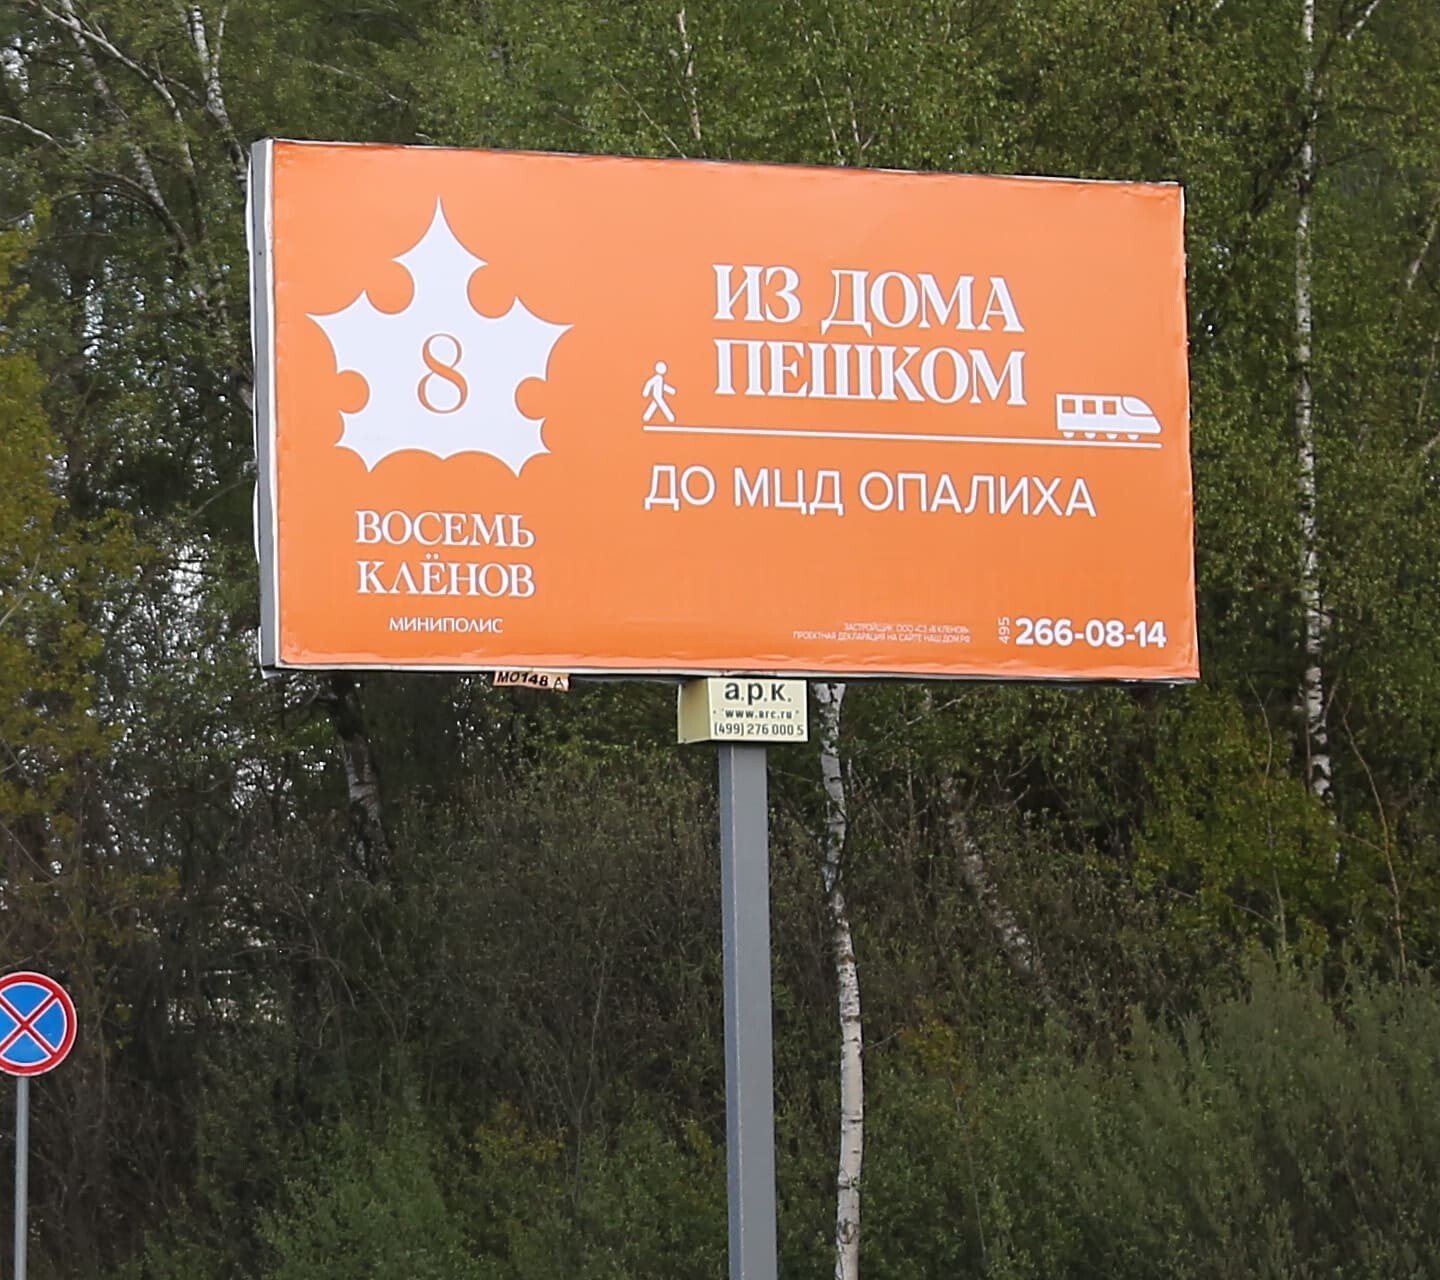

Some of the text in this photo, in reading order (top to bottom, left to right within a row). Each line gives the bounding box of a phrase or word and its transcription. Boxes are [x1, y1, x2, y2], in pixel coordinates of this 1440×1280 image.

[712, 264, 1025, 338] ИЗ ДОМА
[417, 332, 469, 415] 8
[713, 338, 1028, 406] ПЕШКОМ
[643, 464, 1097, 517] ДО МЦД ОПАЛИХА
[355, 510, 536, 548] ВОСЕМЬ
[356, 553, 536, 598] КЛЁНОВ
[388, 616, 504, 634] МИНИПОЛИС
[998, 616, 1010, 645] 495
[1015, 617, 1167, 649] 266-08-14
[724, 682, 792, 706] а.р.к.
[714, 722, 744, 736] (499)
[747, 723, 769, 735] 276
